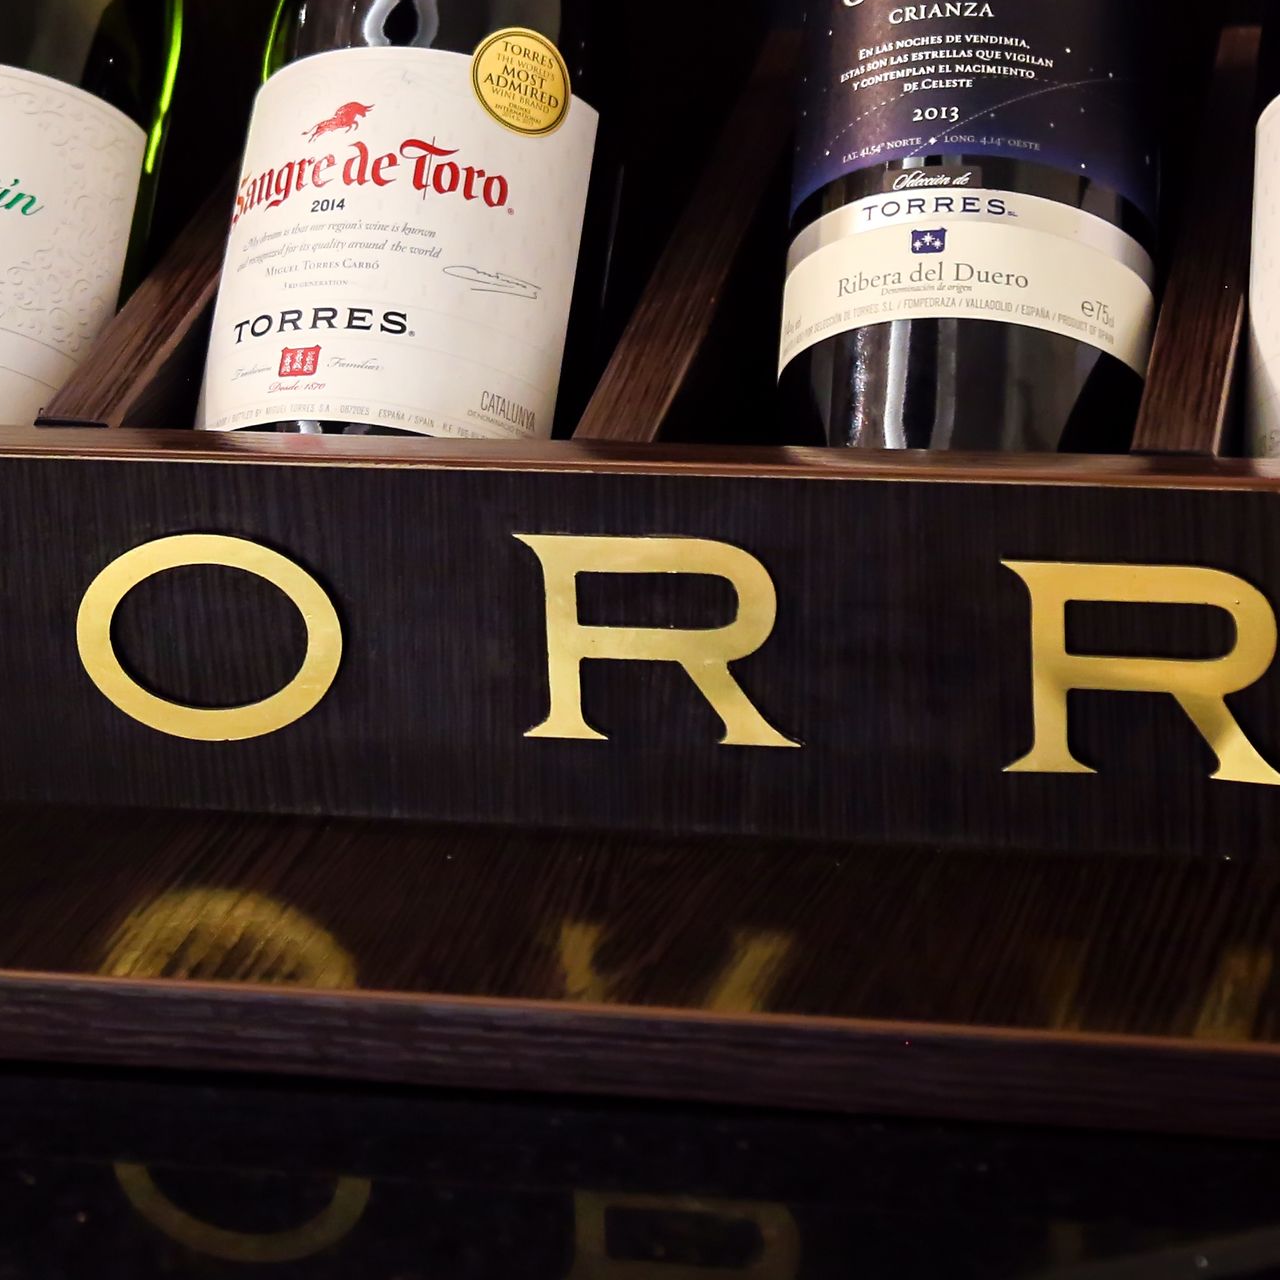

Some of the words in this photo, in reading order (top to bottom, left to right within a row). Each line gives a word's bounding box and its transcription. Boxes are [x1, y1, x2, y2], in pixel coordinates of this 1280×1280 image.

[889, 2, 994, 25] CRIANZA
[502, 41, 554, 69] TORRES
[874, 42, 894, 55] LAS
[895, 35, 943, 50] NOCHES
[945, 34, 962, 44] DE
[497, 53, 514, 64] THE
[840, 67, 864, 83] ESTAS
[866, 58, 887, 71] SON
[889, 54, 909, 66] LAS
[911, 49, 973, 61] ESTRELLAS
[975, 49, 1001, 61] QUE
[1004, 52, 1054, 68] VIGILAN
[502, 65, 545, 89] MOST
[860, 65, 935, 89] CONTEMPLAN
[938, 64, 952, 73] EL
[955, 64, 1035, 79] NACIMIENTO
[484, 73, 559, 108] ADMIRED
[491, 86, 515, 100] WINE
[519, 96, 550, 113] BRAND
[912, 106, 960, 122] 2013
[886, 137, 922, 149] NORTE
[944, 135, 975, 144] LONG.
[1007, 139, 1040, 151] OESTE
[231, 153, 337, 225] Sangre
[342, 141, 401, 186] de
[400, 136, 508, 208] Toro
[892, 170, 950, 191] Selección
[952, 171, 972, 186] de
[310, 198, 346, 212] 2014
[863, 196, 1006, 221] TORRES
[291, 223, 308, 235] that
[365, 222, 389, 232] wine
[391, 223, 400, 232] is
[401, 222, 437, 238] known
[311, 238, 347, 255] quality
[348, 239, 387, 251] around
[390, 239, 407, 252] the
[410, 246, 442, 259] world
[837, 272, 901, 298] Ribera
[909, 261, 943, 282] del
[953, 262, 1029, 289] Duero
[947, 284, 972, 295] origen
[1021, 305, 1050, 320] ESPAÑA
[234, 307, 407, 344] TORRES
[481, 390, 535, 432] CATALUNYA
